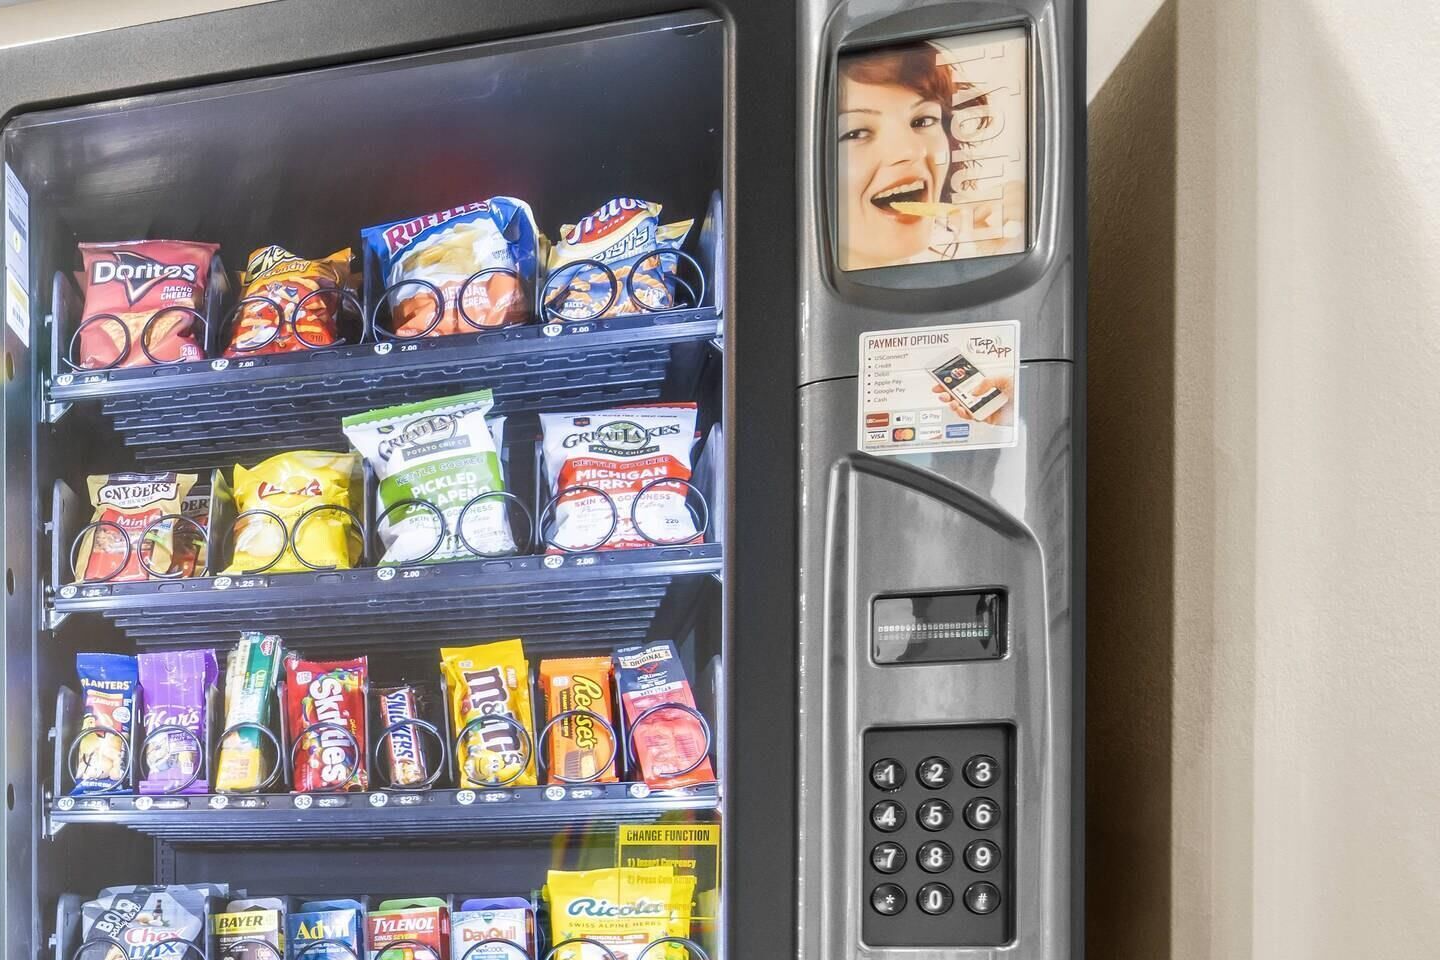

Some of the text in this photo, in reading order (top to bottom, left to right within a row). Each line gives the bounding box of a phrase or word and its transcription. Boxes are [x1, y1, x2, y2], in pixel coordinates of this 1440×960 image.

[385, 201, 490, 254] RUFFLES
[93, 262, 198, 283] Doritos
[161, 292, 192, 300] CHEESE
[163, 286, 192, 294] NACHO
[545, 326, 559, 335] 16
[376, 344, 390, 352] 14
[869, 334, 949, 349] PAYMENT OPTIONS
[970, 337, 993, 349] Tap
[987, 344, 1012, 358] App
[623, 424, 680, 443] LAKES
[870, 432, 885, 440] VISA
[406, 445, 437, 456] POTATO
[593, 447, 623, 455] POTATO
[576, 466, 667, 481] MICHIGAN
[411, 472, 476, 498] PICKLED
[575, 498, 596, 507] SKIN
[117, 515, 147, 527] Mini
[546, 557, 562, 566] 26
[379, 569, 394, 578] 24
[215, 579, 231, 588] 22
[235, 580, 254, 588] 1.25
[630, 653, 663, 667] ORIGINAL
[884, 764, 894, 784] 1
[930, 763, 944, 782] 2
[976, 762, 991, 782] 3
[371, 794, 386, 804] 34
[459, 792, 474, 802] 35
[547, 788, 563, 797] 36
[60, 798, 73, 808] 30
[296, 796, 311, 807] 33
[882, 806, 896, 826] 4
[929, 806, 943, 825] 5
[975, 804, 991, 824] 6
[627, 830, 710, 841] CHANGE FUNCTION
[883, 848, 896, 868] 7
[929, 847, 943, 867] 8
[976, 847, 991, 866] 9
[929, 890, 942, 909] 0
[568, 899, 663, 917] Ricola
[219, 915, 263, 928] BAYER
[373, 917, 434, 933] TYLENOL
[125, 927, 184, 944] Chex
[296, 919, 350, 940] Advil
[463, 926, 517, 942] DayQuil
